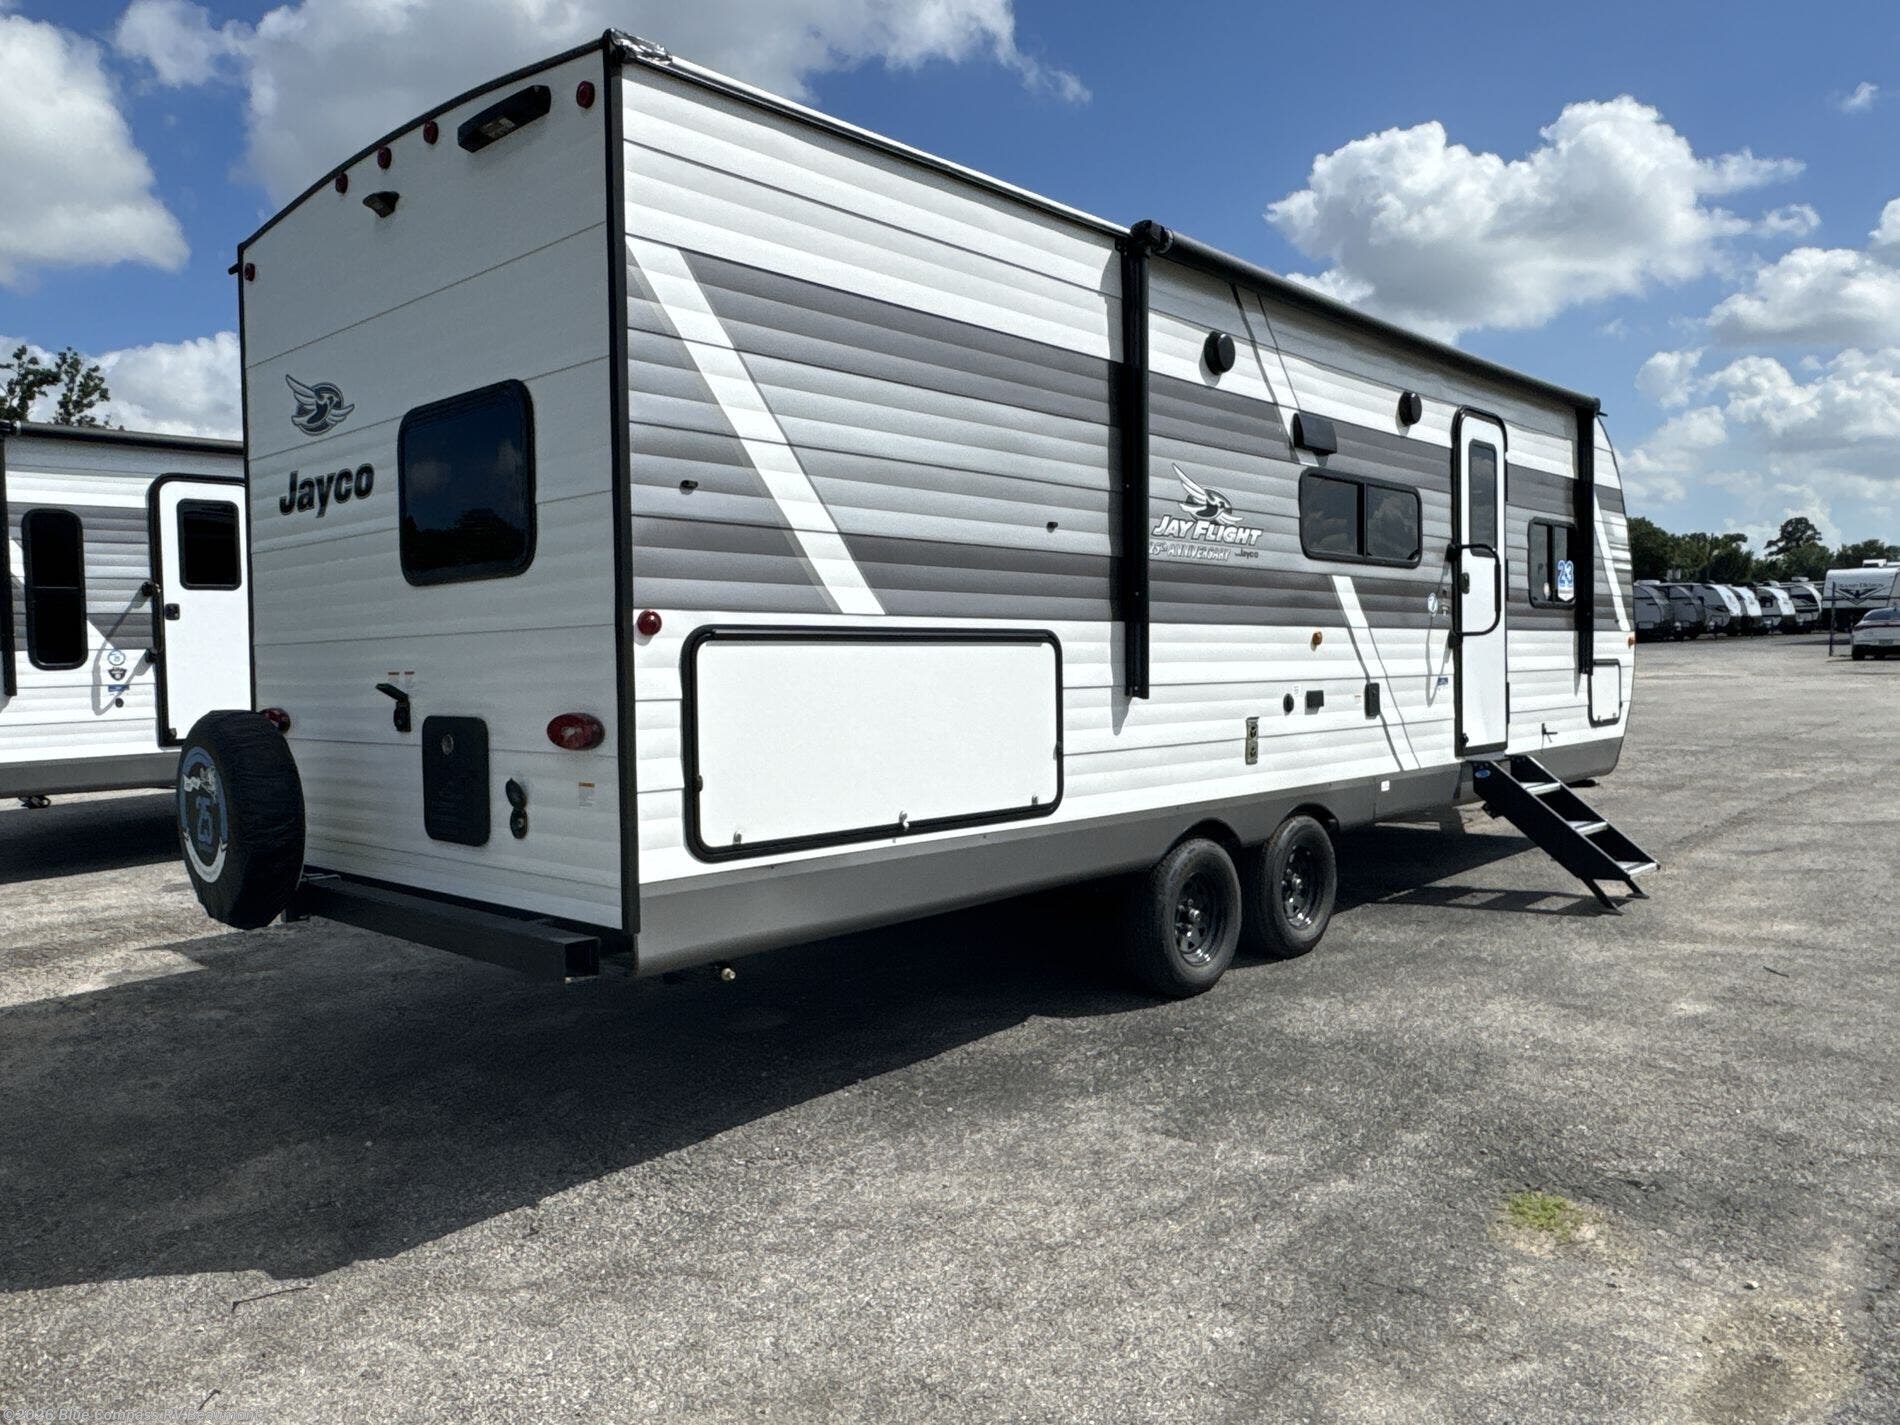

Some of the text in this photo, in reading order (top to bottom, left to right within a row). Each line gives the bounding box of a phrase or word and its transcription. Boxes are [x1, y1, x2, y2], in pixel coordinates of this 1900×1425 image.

[279, 463, 375, 518] Jayco
[1151, 514, 1264, 546] JAY FLIGHT
